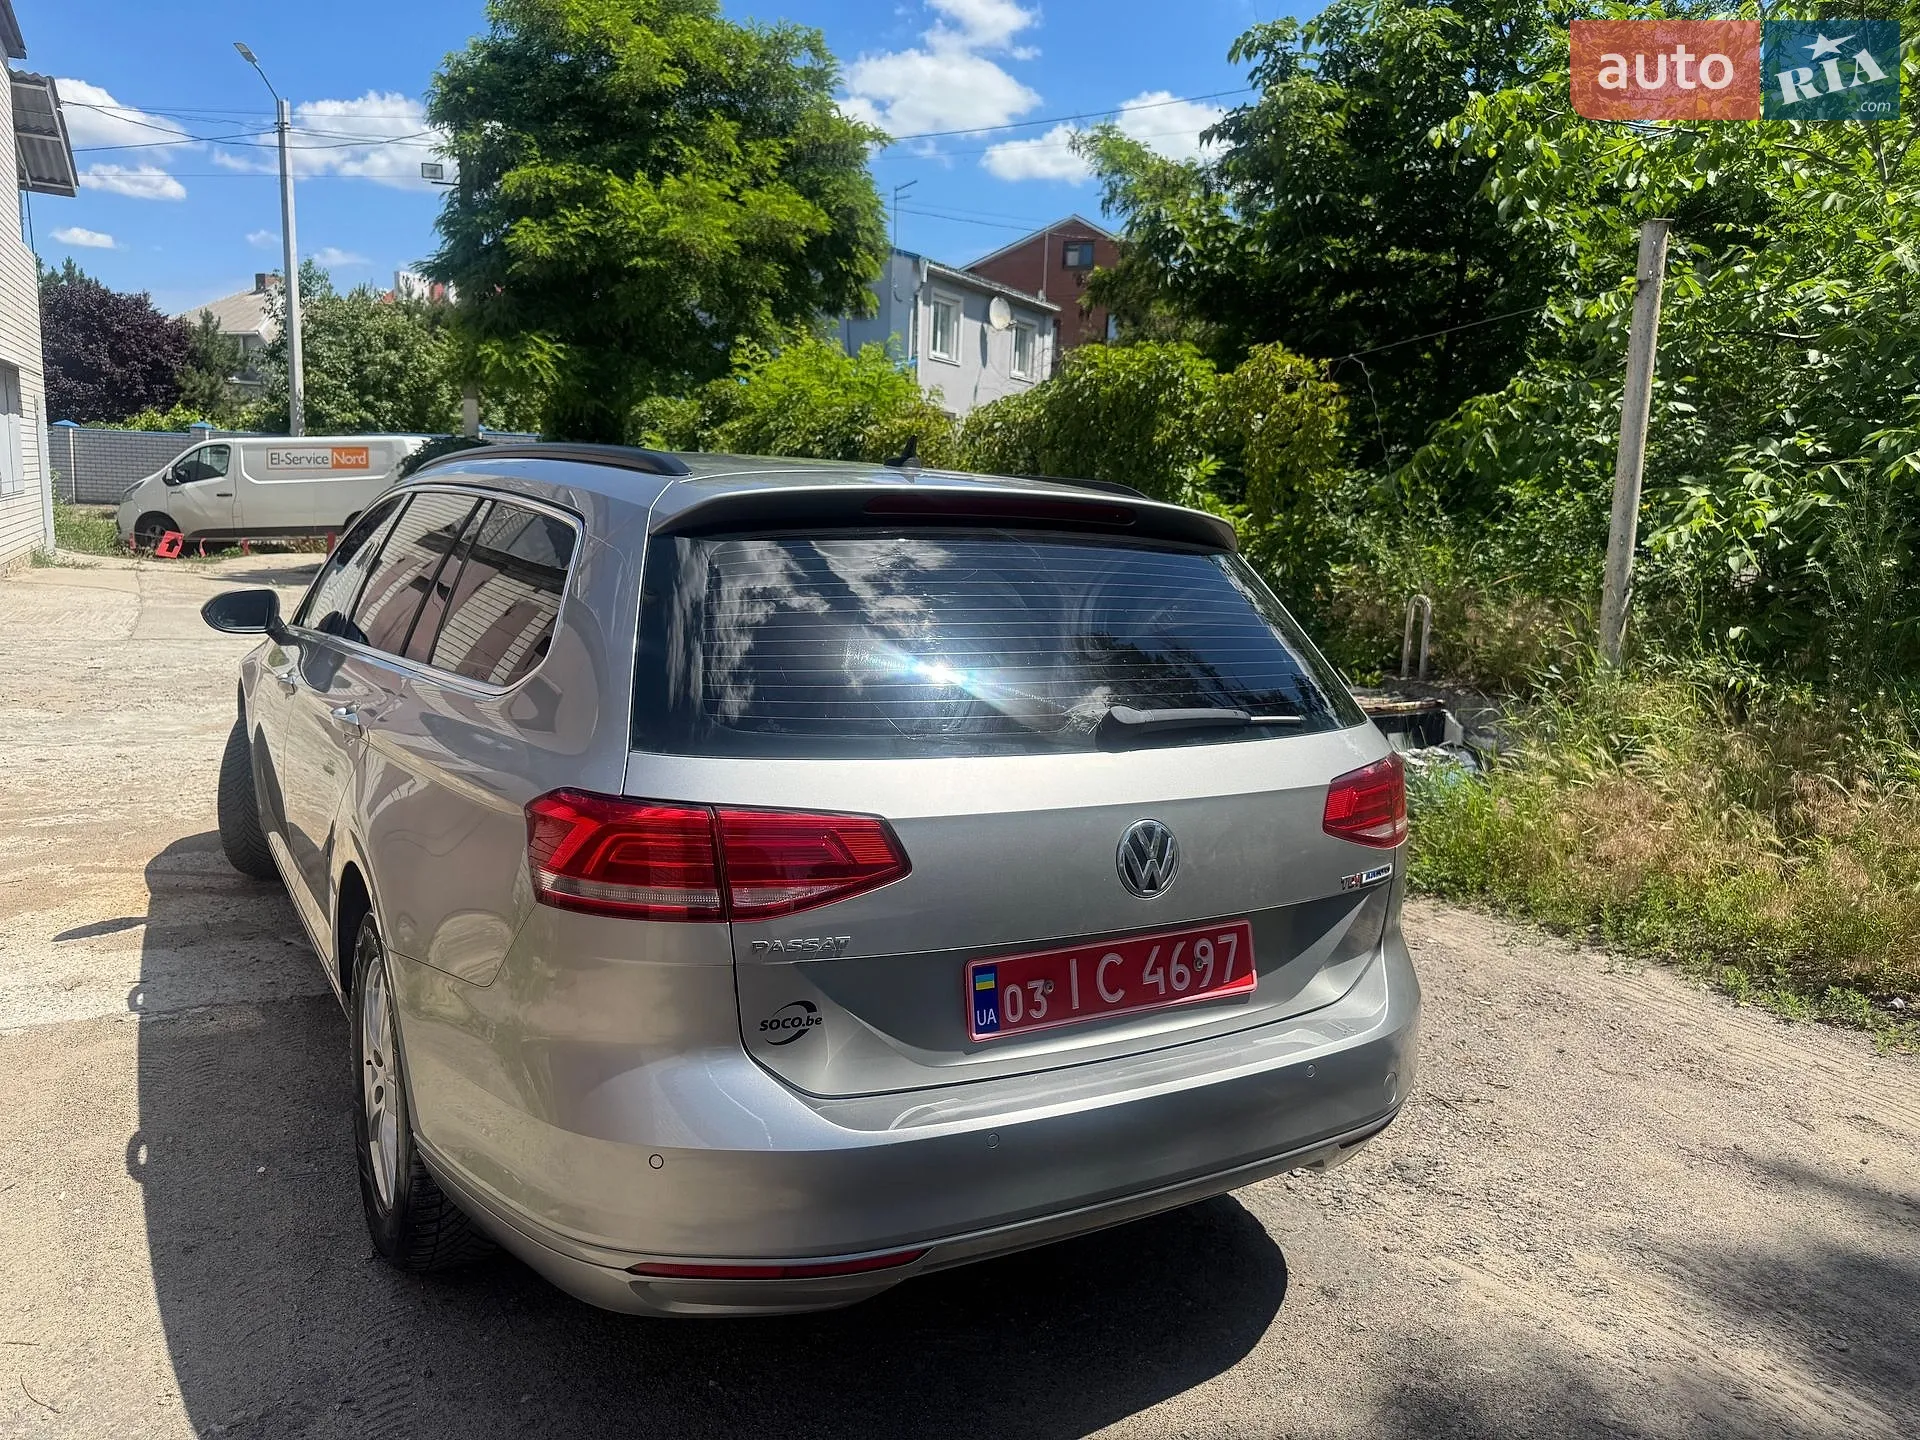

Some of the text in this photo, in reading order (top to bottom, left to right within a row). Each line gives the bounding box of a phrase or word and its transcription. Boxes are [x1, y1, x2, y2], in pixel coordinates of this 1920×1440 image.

[332, 451, 367, 465] Nord
[751, 935, 851, 953] PASSAT
[1004, 977, 1050, 1023] 03
[1143, 932, 1238, 995] 4697
[976, 1006, 998, 1026] UA
